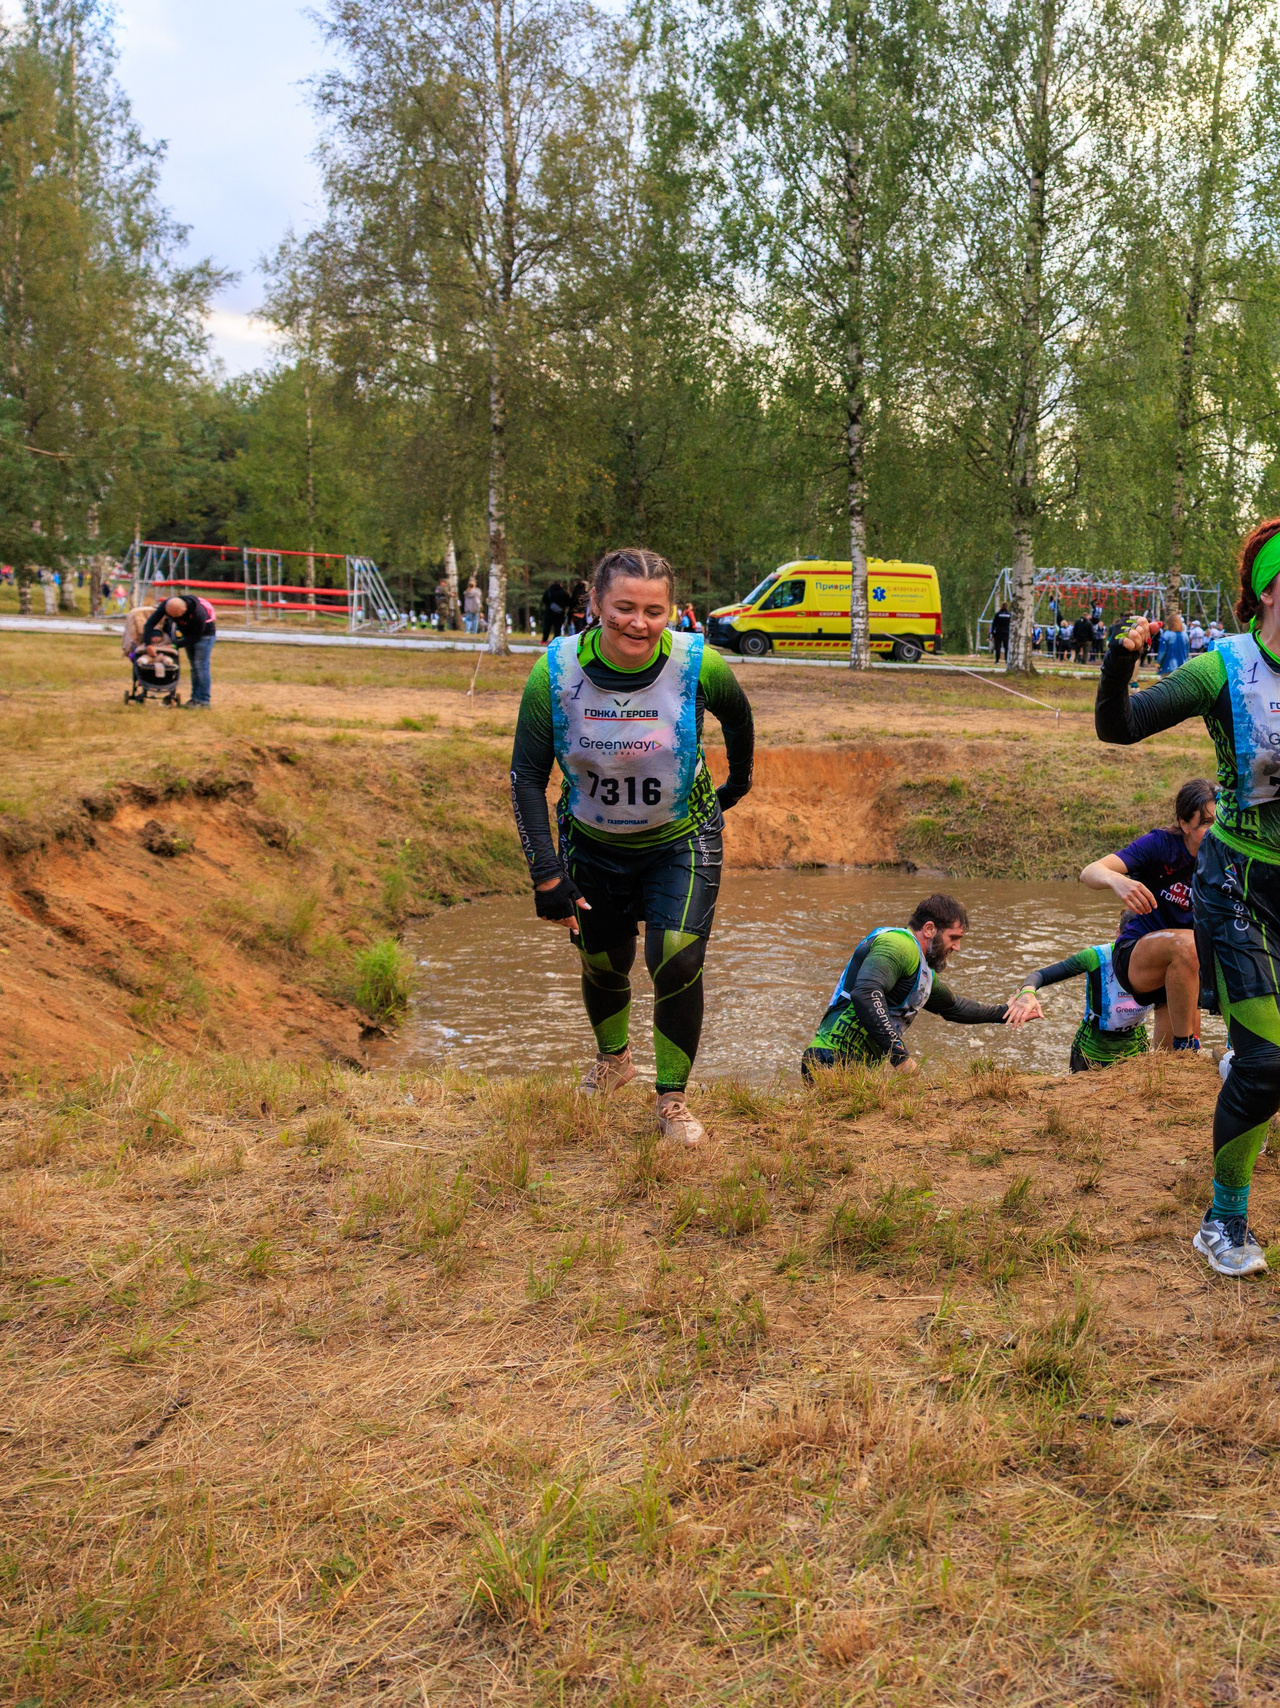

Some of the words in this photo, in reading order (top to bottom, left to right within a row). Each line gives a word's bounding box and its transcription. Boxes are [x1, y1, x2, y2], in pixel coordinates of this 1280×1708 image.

[1247, 661, 1259, 684] 1
[570, 679, 584, 700] 1
[584, 708, 618, 718] ГОНКА
[620, 709, 659, 718] ГЕРОЕВ
[579, 736, 652, 752] Greenway
[586, 769, 662, 806] 7316
[1160, 889, 1190, 908] ГОНКА
[870, 989, 902, 1043] Greenway
